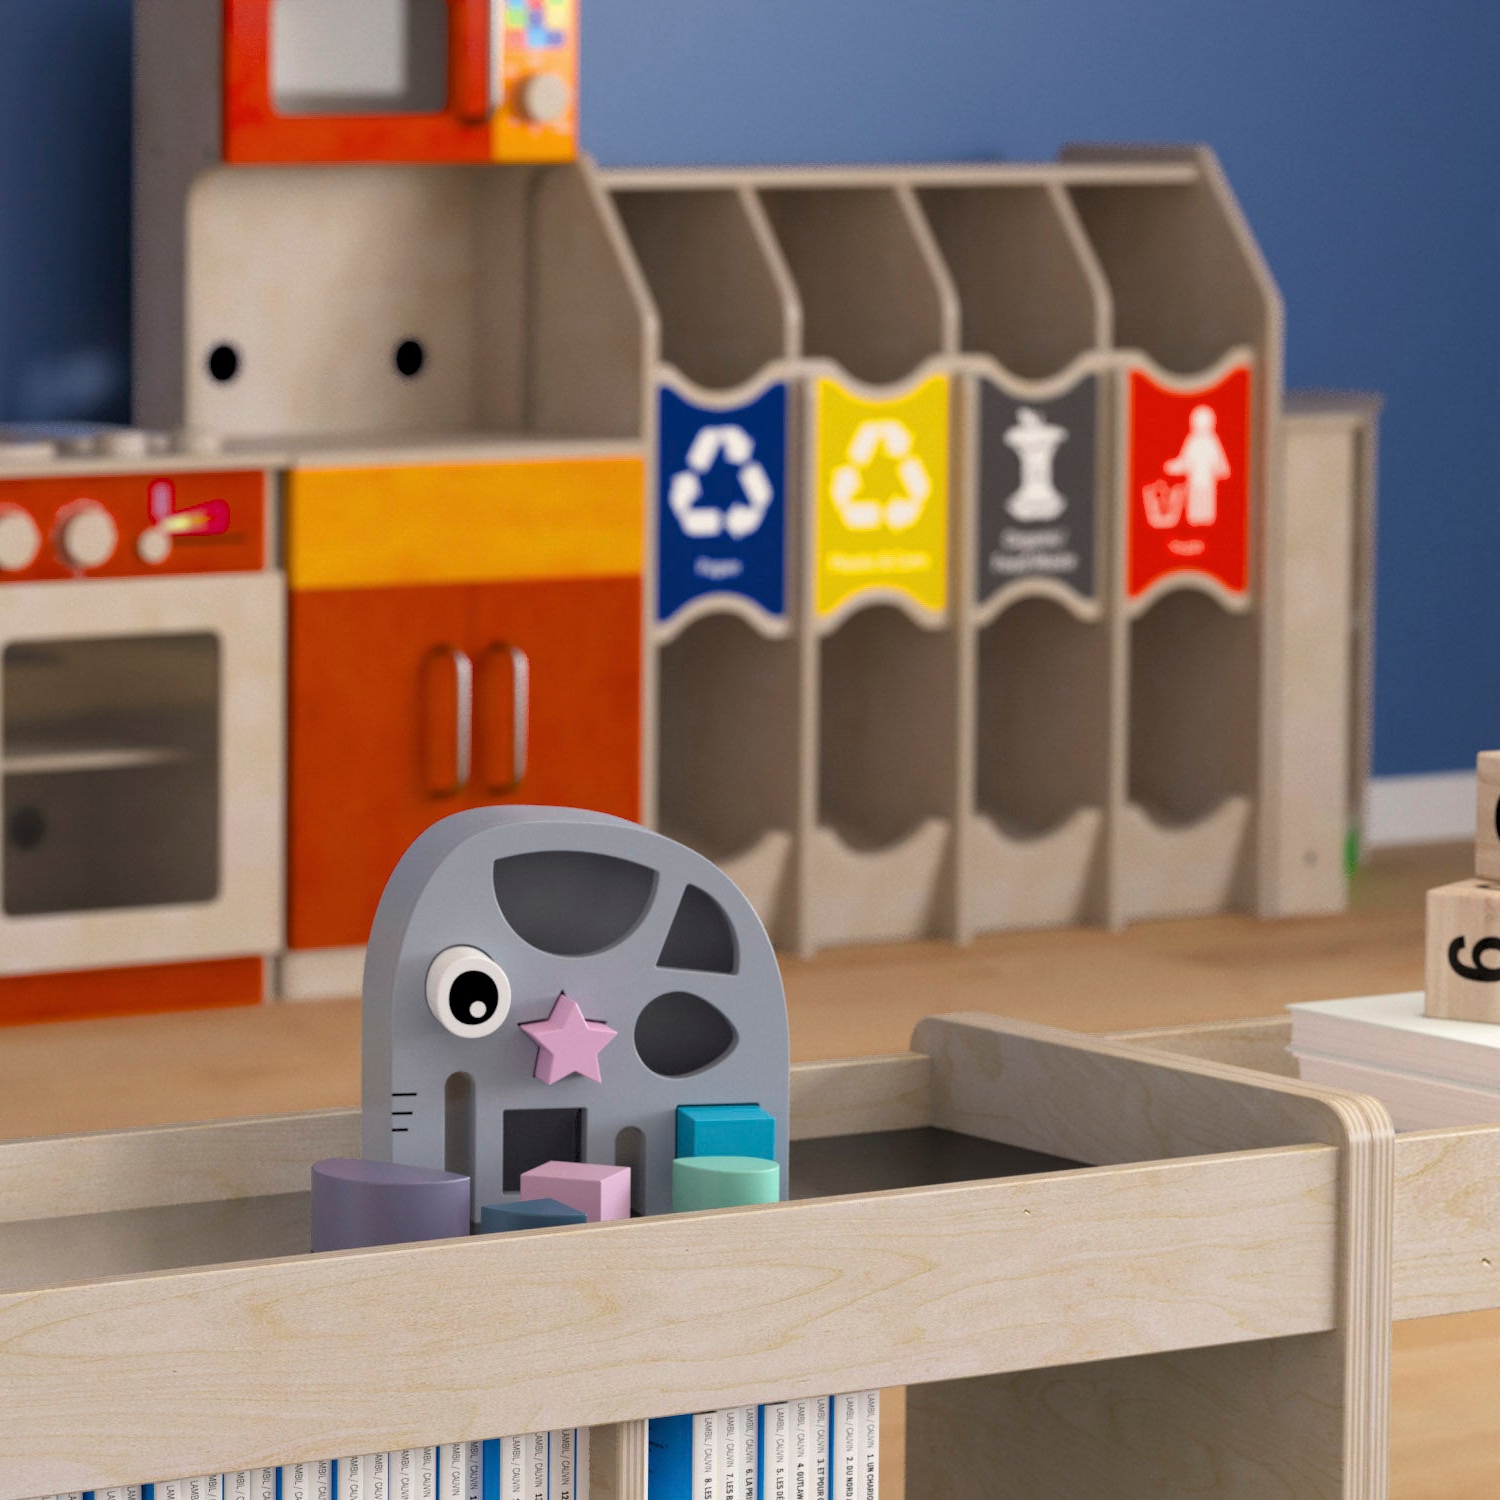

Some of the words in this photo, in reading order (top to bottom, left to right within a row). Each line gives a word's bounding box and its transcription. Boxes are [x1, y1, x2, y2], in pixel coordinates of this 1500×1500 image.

[815, 1467, 826, 1475] ET
[865, 1462, 876, 1472] UN
[744, 1468, 755, 1476] 6.
[744, 1477, 755, 1486] LA
[815, 1476, 826, 1496] POUR
[702, 1486, 714, 1500] LES
